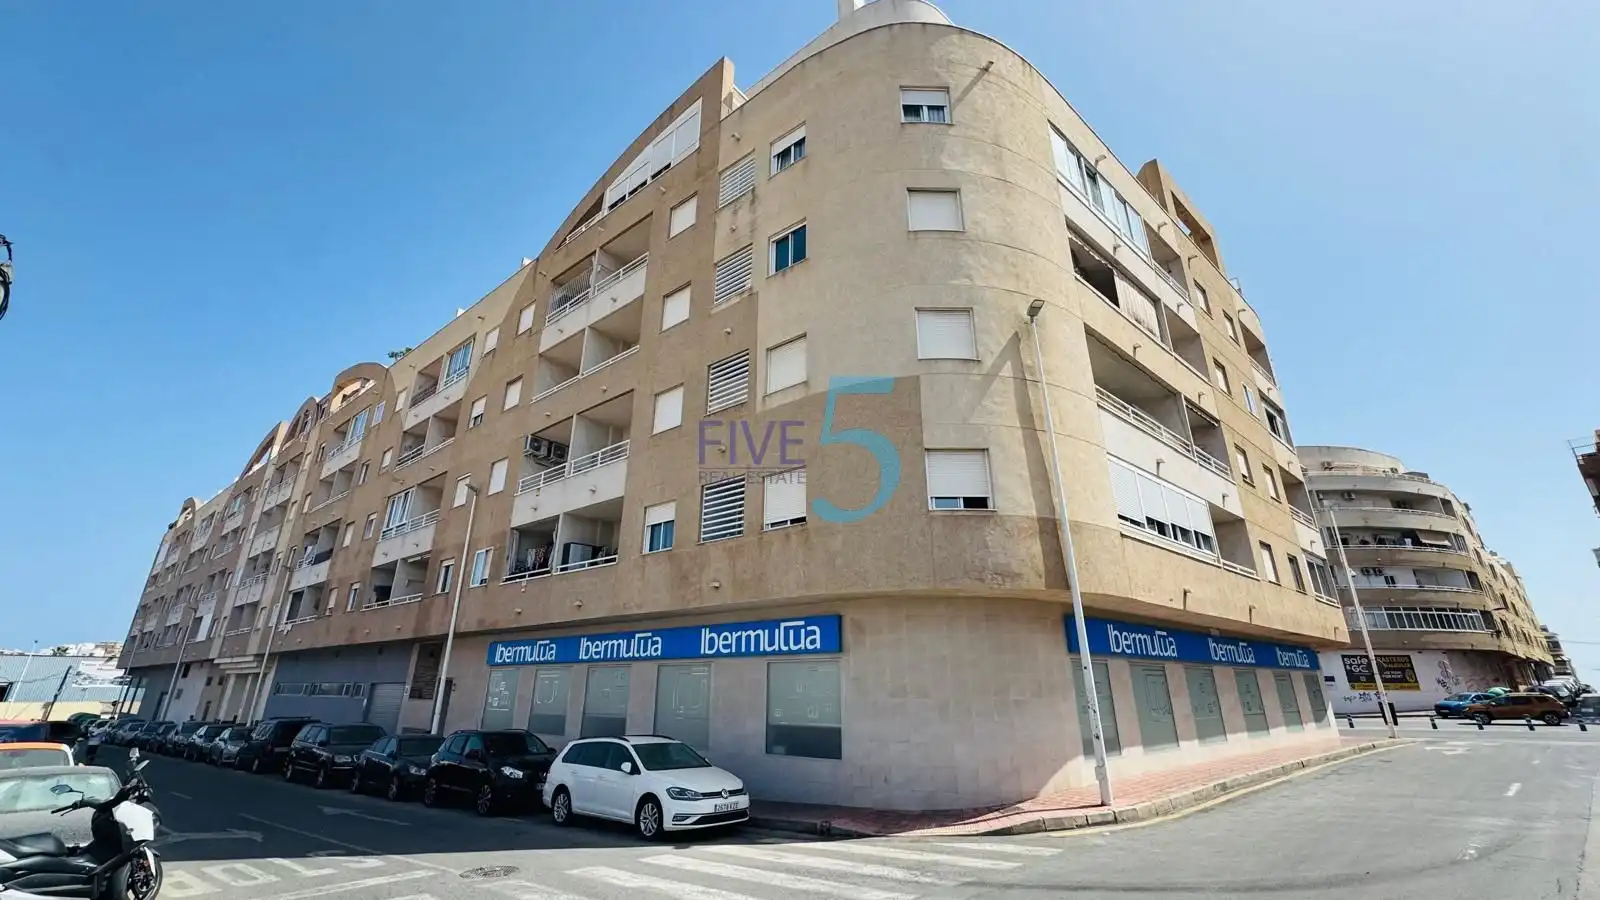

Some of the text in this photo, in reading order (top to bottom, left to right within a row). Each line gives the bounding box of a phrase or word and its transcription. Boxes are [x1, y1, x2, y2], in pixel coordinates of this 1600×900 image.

[578, 632, 662, 660] Ibermutua
[700, 620, 821, 655] Ibermutua
[1106, 623, 1178, 658] Ibermutua
[1207, 637, 1256, 664] Ibermutua
[494, 640, 557, 663] Ibermutua
[1275, 646, 1311, 668] Ibermutua
[1343, 656, 1368, 665] safe
